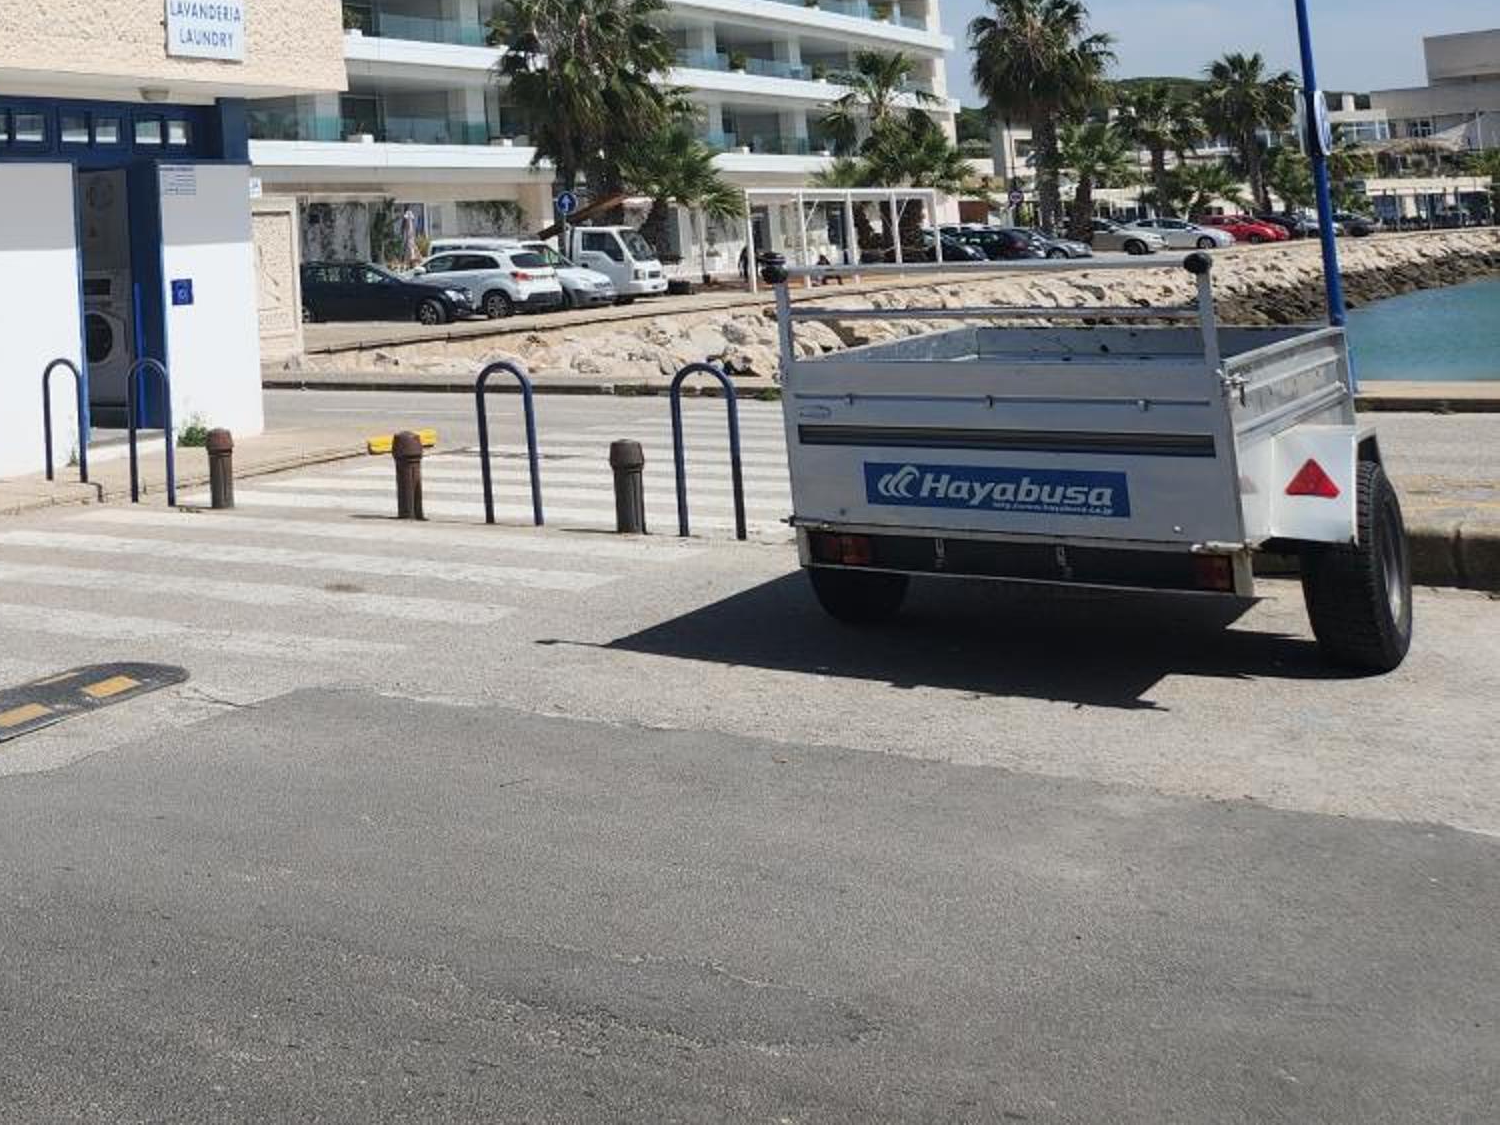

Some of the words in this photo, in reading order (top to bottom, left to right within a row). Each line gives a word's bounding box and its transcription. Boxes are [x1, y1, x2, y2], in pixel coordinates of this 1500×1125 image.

[170, 0, 241, 22] LAVANDERIA
[179, 27, 233, 51] LAUNDRY
[920, 473, 1113, 506] Hayabusa
